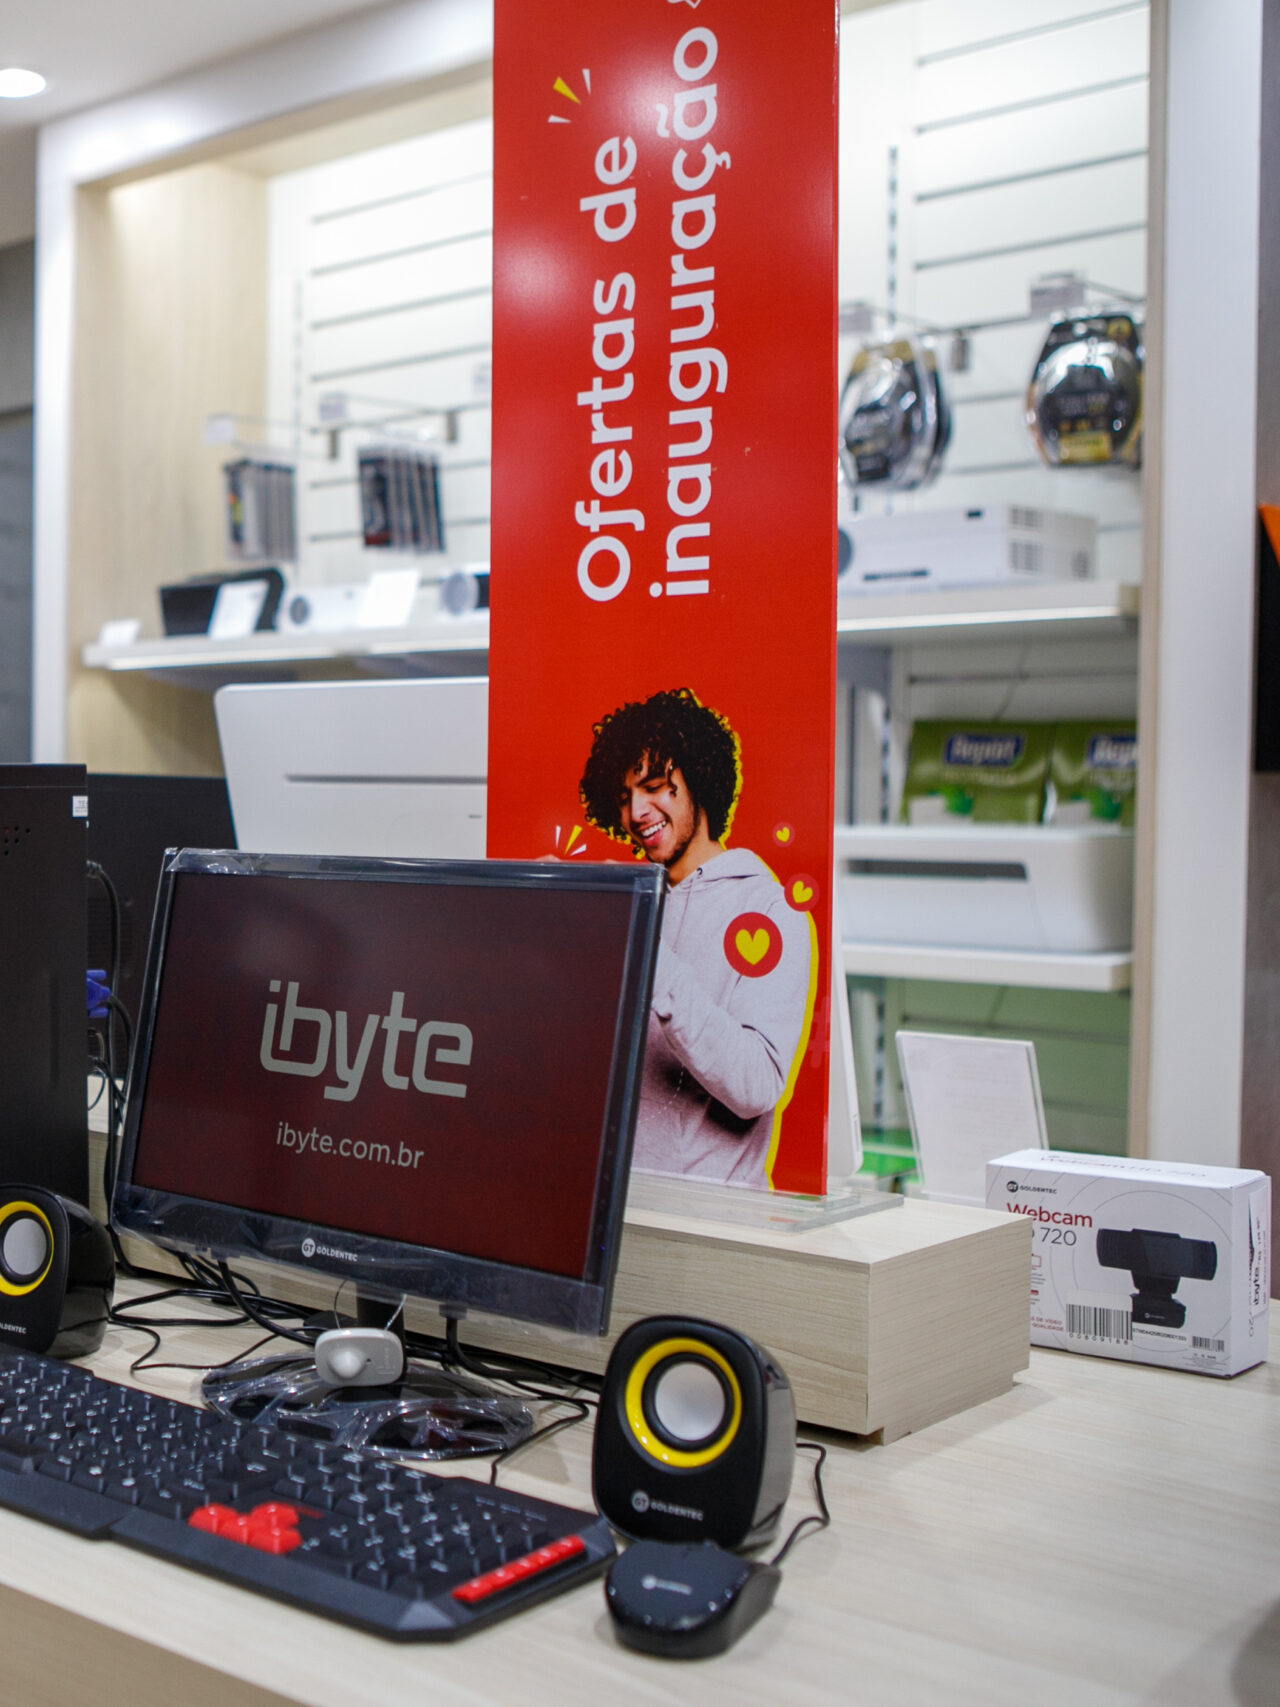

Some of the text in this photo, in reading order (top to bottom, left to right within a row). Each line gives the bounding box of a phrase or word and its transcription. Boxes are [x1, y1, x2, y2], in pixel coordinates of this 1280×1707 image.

[649, 27, 731, 596] inauguração
[575, 136, 645, 602] Ofertas de
[260, 980, 474, 1102] ibyte
[276, 1121, 425, 1168] ibyte.com.br
[1020, 1185, 1058, 1195] GOLDENTEC
[1007, 1202, 1093, 1228] Webcam
[1040, 1227, 1077, 1247] 720
[316, 1246, 358, 1261] GOLDENTEC
[650, 1501, 704, 1521] GOLDENTEC
